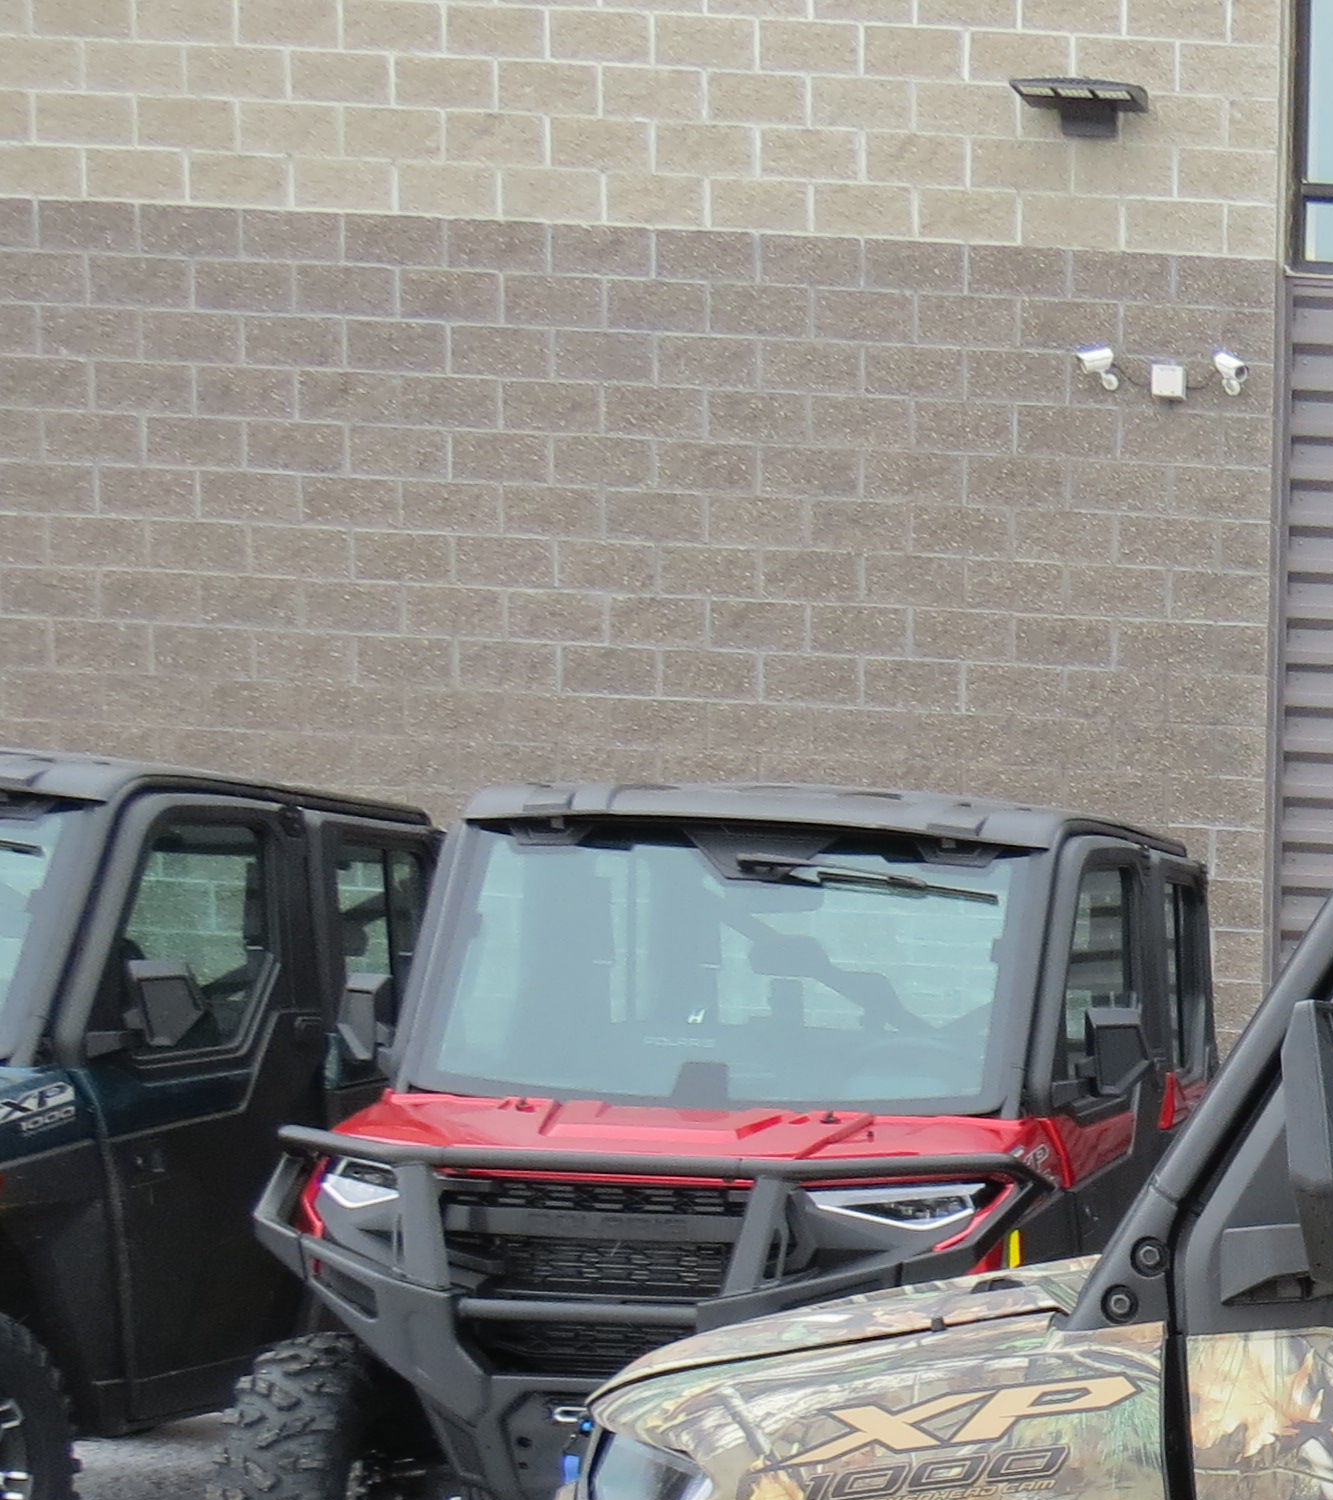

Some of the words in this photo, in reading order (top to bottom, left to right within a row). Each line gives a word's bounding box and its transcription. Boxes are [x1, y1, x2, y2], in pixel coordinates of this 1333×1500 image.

[0, 1081, 76, 1124] XP
[21, 1105, 76, 1131] 1000
[752, 1375, 1142, 1473] XP
[1001, 1479, 1057, 1494] CAM
